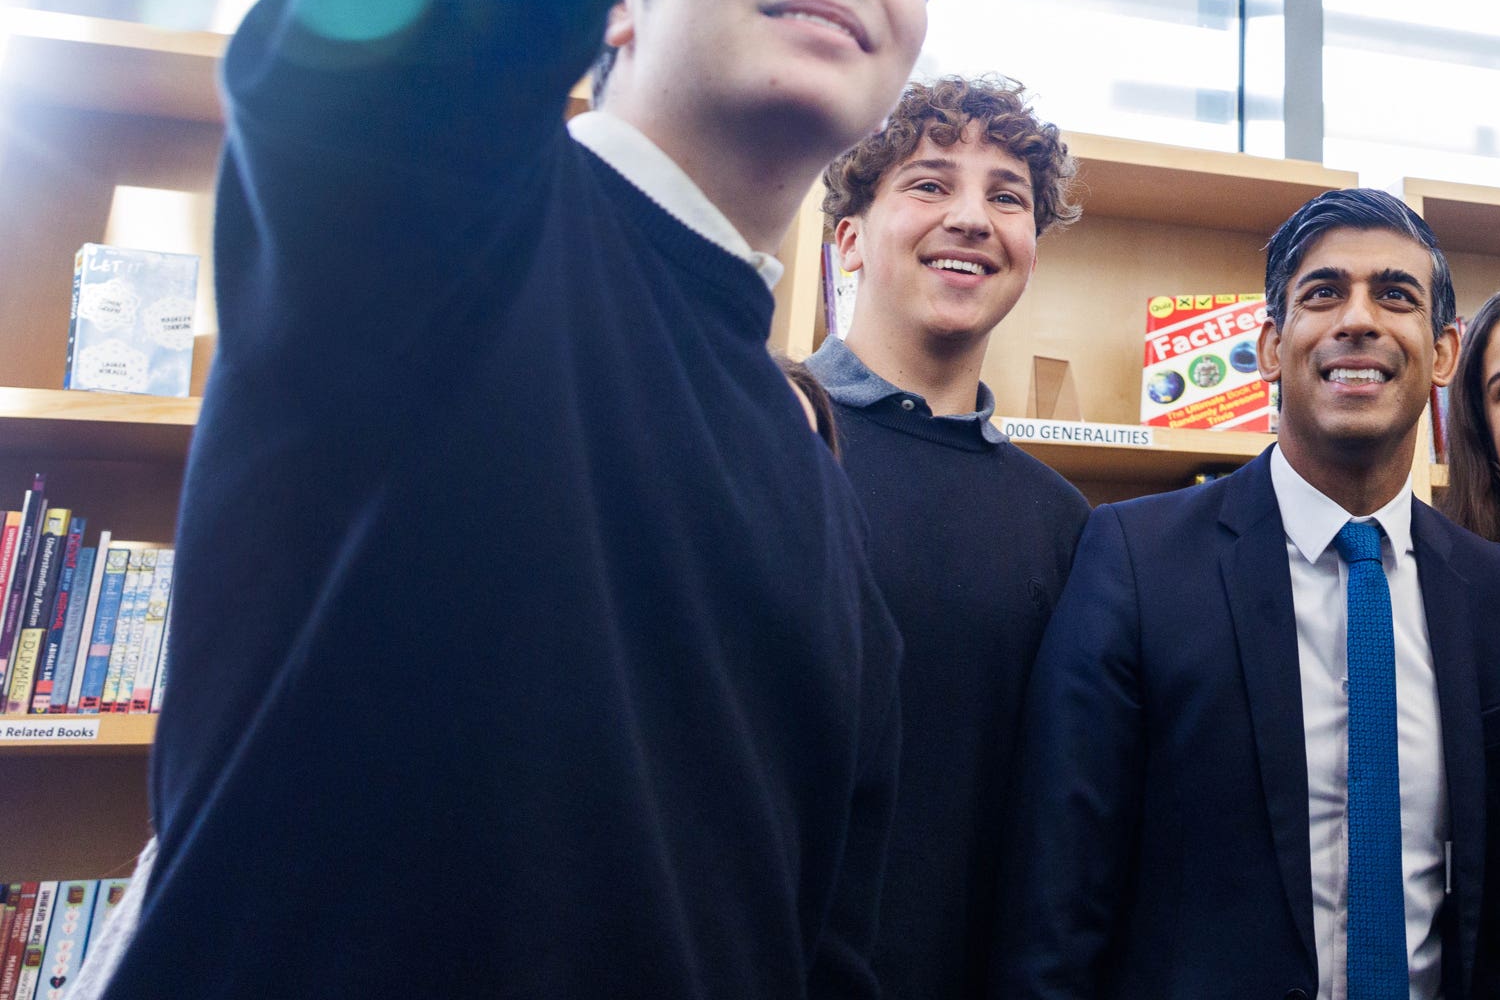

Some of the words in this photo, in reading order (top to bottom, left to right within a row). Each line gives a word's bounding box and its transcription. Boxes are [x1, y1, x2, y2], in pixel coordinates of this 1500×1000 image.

[90, 257, 123, 273] LET
[1152, 307, 1268, 361] FactFee
[1168, 410, 1184, 420] The
[1185, 395, 1226, 414] Ultimate
[1226, 386, 1251, 399] Book
[1251, 381, 1262, 390] of
[1169, 408, 1218, 428] Randomly
[1219, 390, 1266, 412] Awesome
[1006, 423, 1035, 438] 000
[1040, 425, 1149, 445] GENERALITIES
[1207, 411, 1235, 426] Trivia
[33, 536, 56, 598] Understanding
[29, 596, 45, 627] Autism
[6, 727, 54, 737] Related
[57, 727, 94, 737] Books
